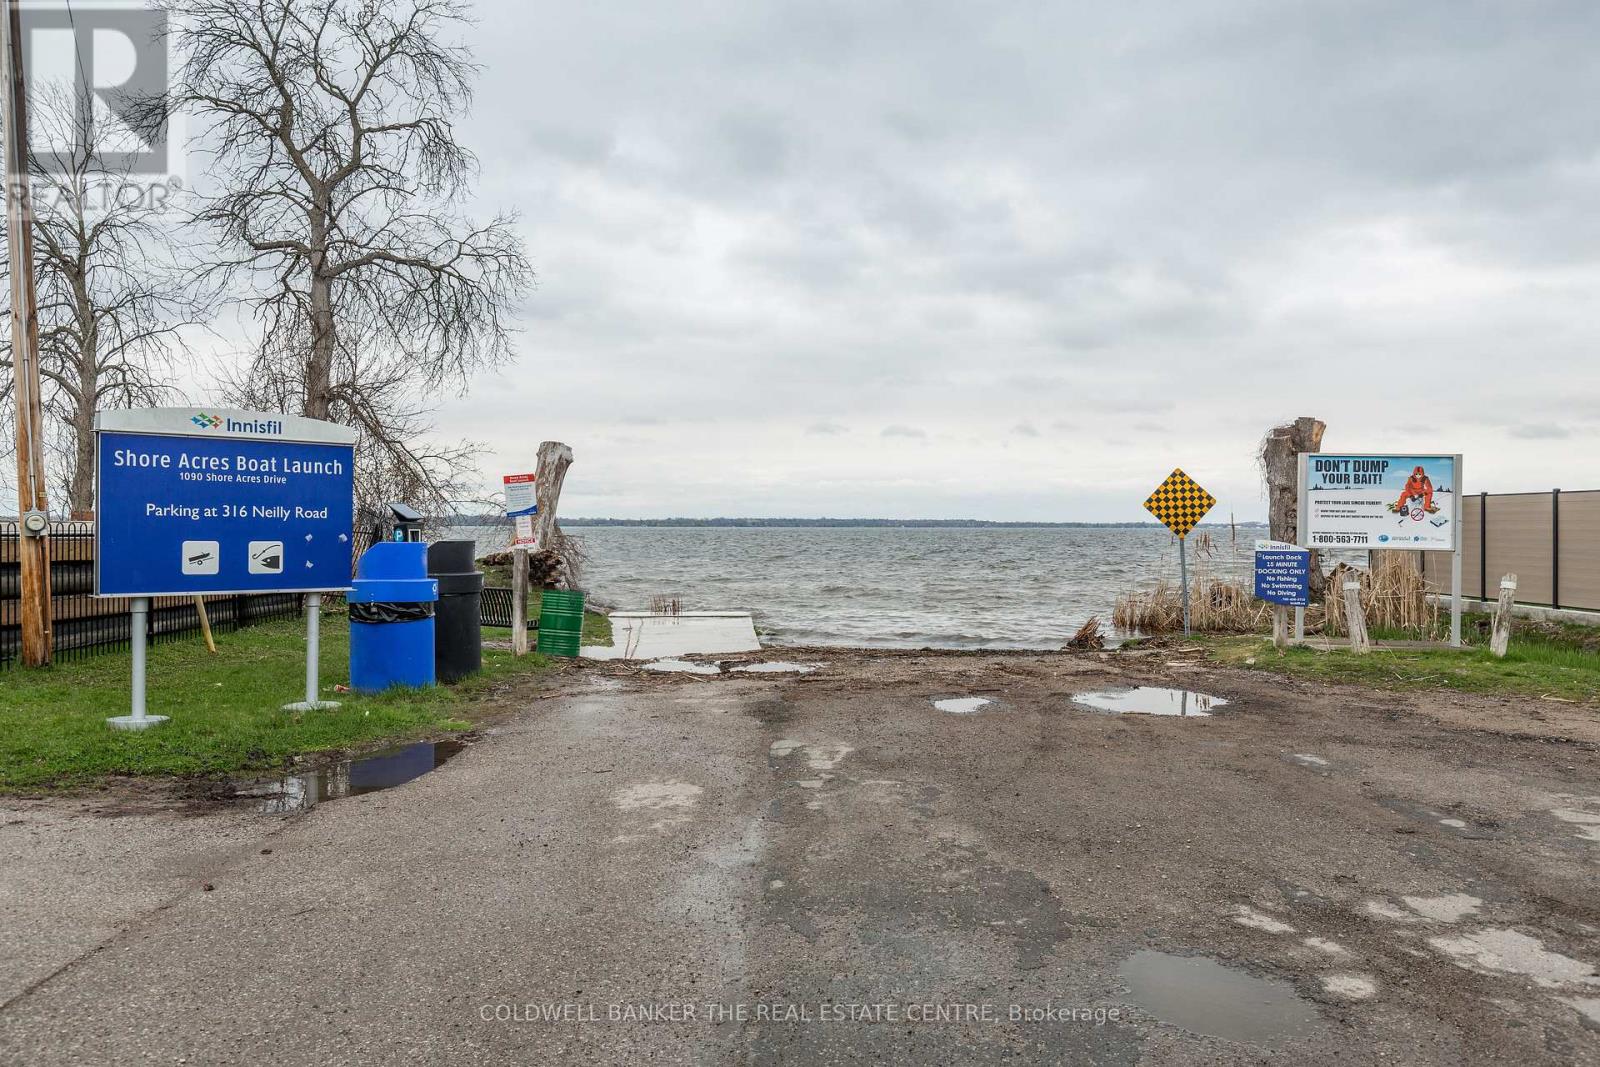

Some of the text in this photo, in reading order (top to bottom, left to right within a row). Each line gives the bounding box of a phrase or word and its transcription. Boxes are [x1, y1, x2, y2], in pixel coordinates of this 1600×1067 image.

[226, 418, 282, 435] Innisfil
[114, 449, 343, 475] Shore Acres Boat Launch
[1315, 459, 1389, 473] DON'T DUMP
[179, 472, 287, 484] 1090 Shore Acres Drive
[1322, 473, 1382, 485] YOUR BAIT!
[145, 503, 328, 522] Parking at 316 Neilly Road
[1312, 535, 1368, 543] 1-800-563-7711
